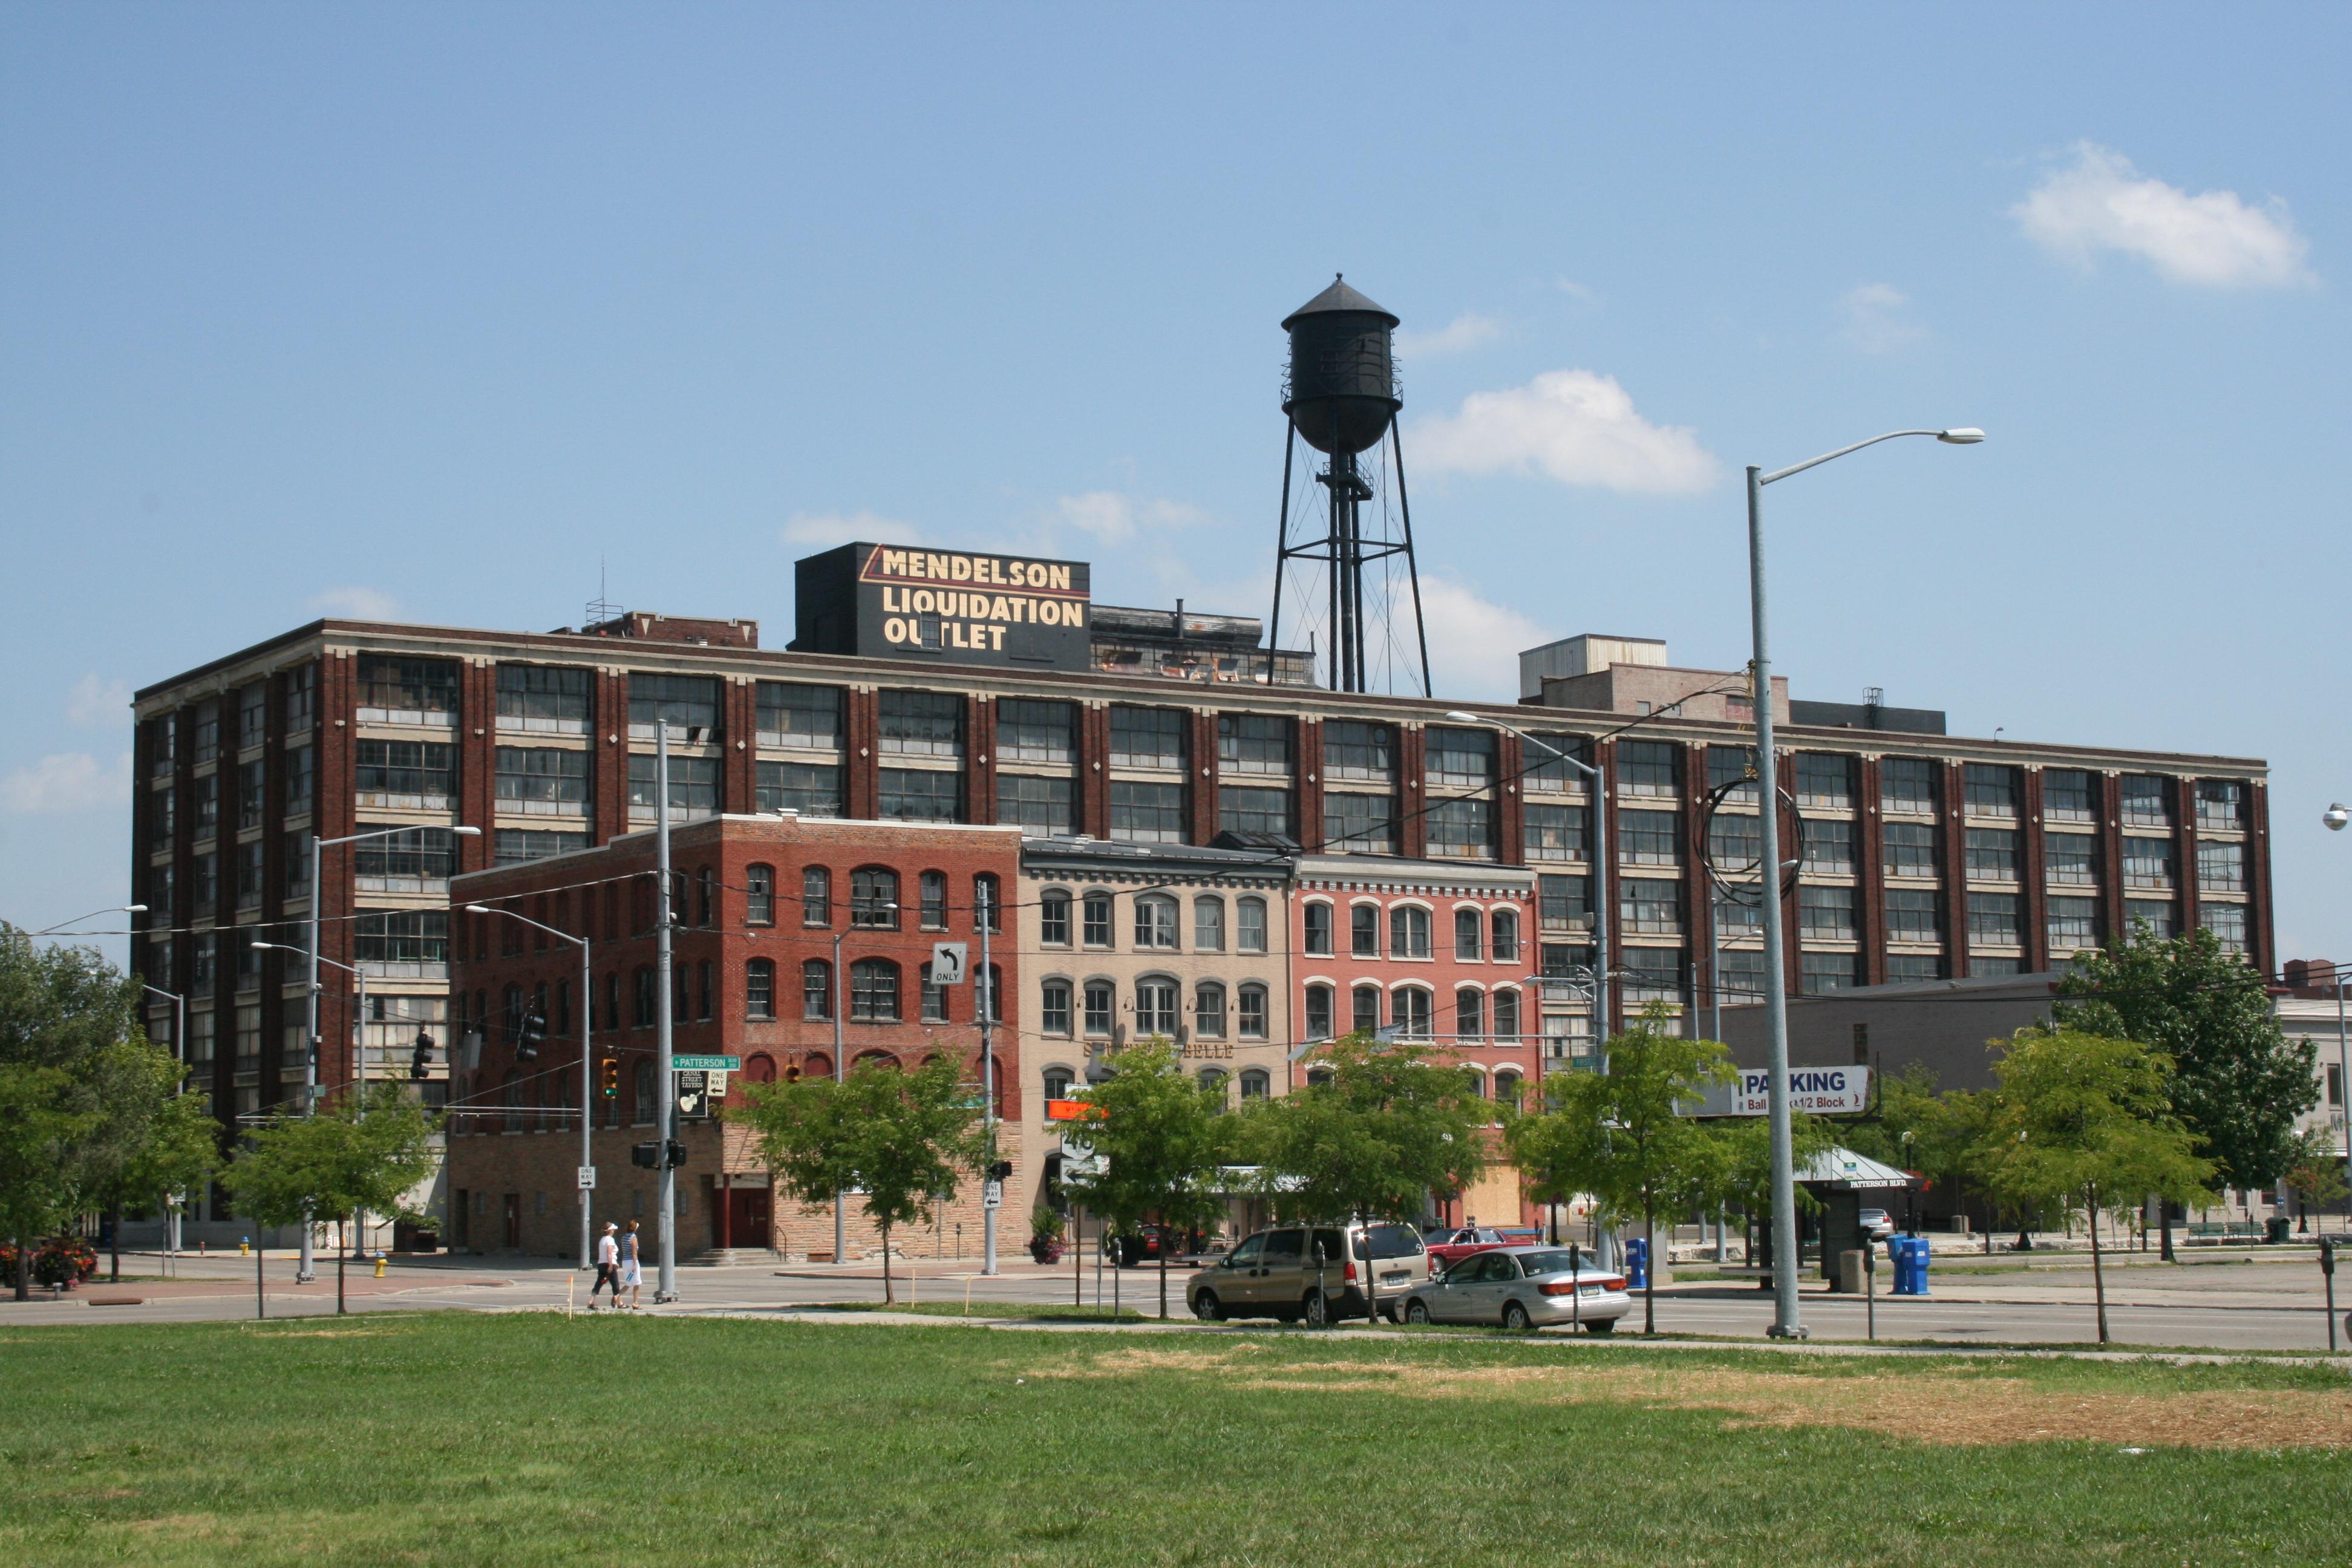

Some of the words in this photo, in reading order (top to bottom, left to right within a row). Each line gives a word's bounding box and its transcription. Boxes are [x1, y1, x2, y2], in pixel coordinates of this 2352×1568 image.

[883, 549, 1070, 590] MENDELSON
[883, 586, 1083, 627] LIQUIDATION
[936, 973, 959, 981] ONLY
[1183, 1044, 1234, 1058] BELLE
[679, 1058, 725, 1067] PATTERSON
[1746, 1072, 1845, 1094] PAKING
[1748, 1099, 1766, 1110] Ball
[1816, 1096, 1845, 1108] Block
[1850, 1180, 1888, 1189] PATTERSON
